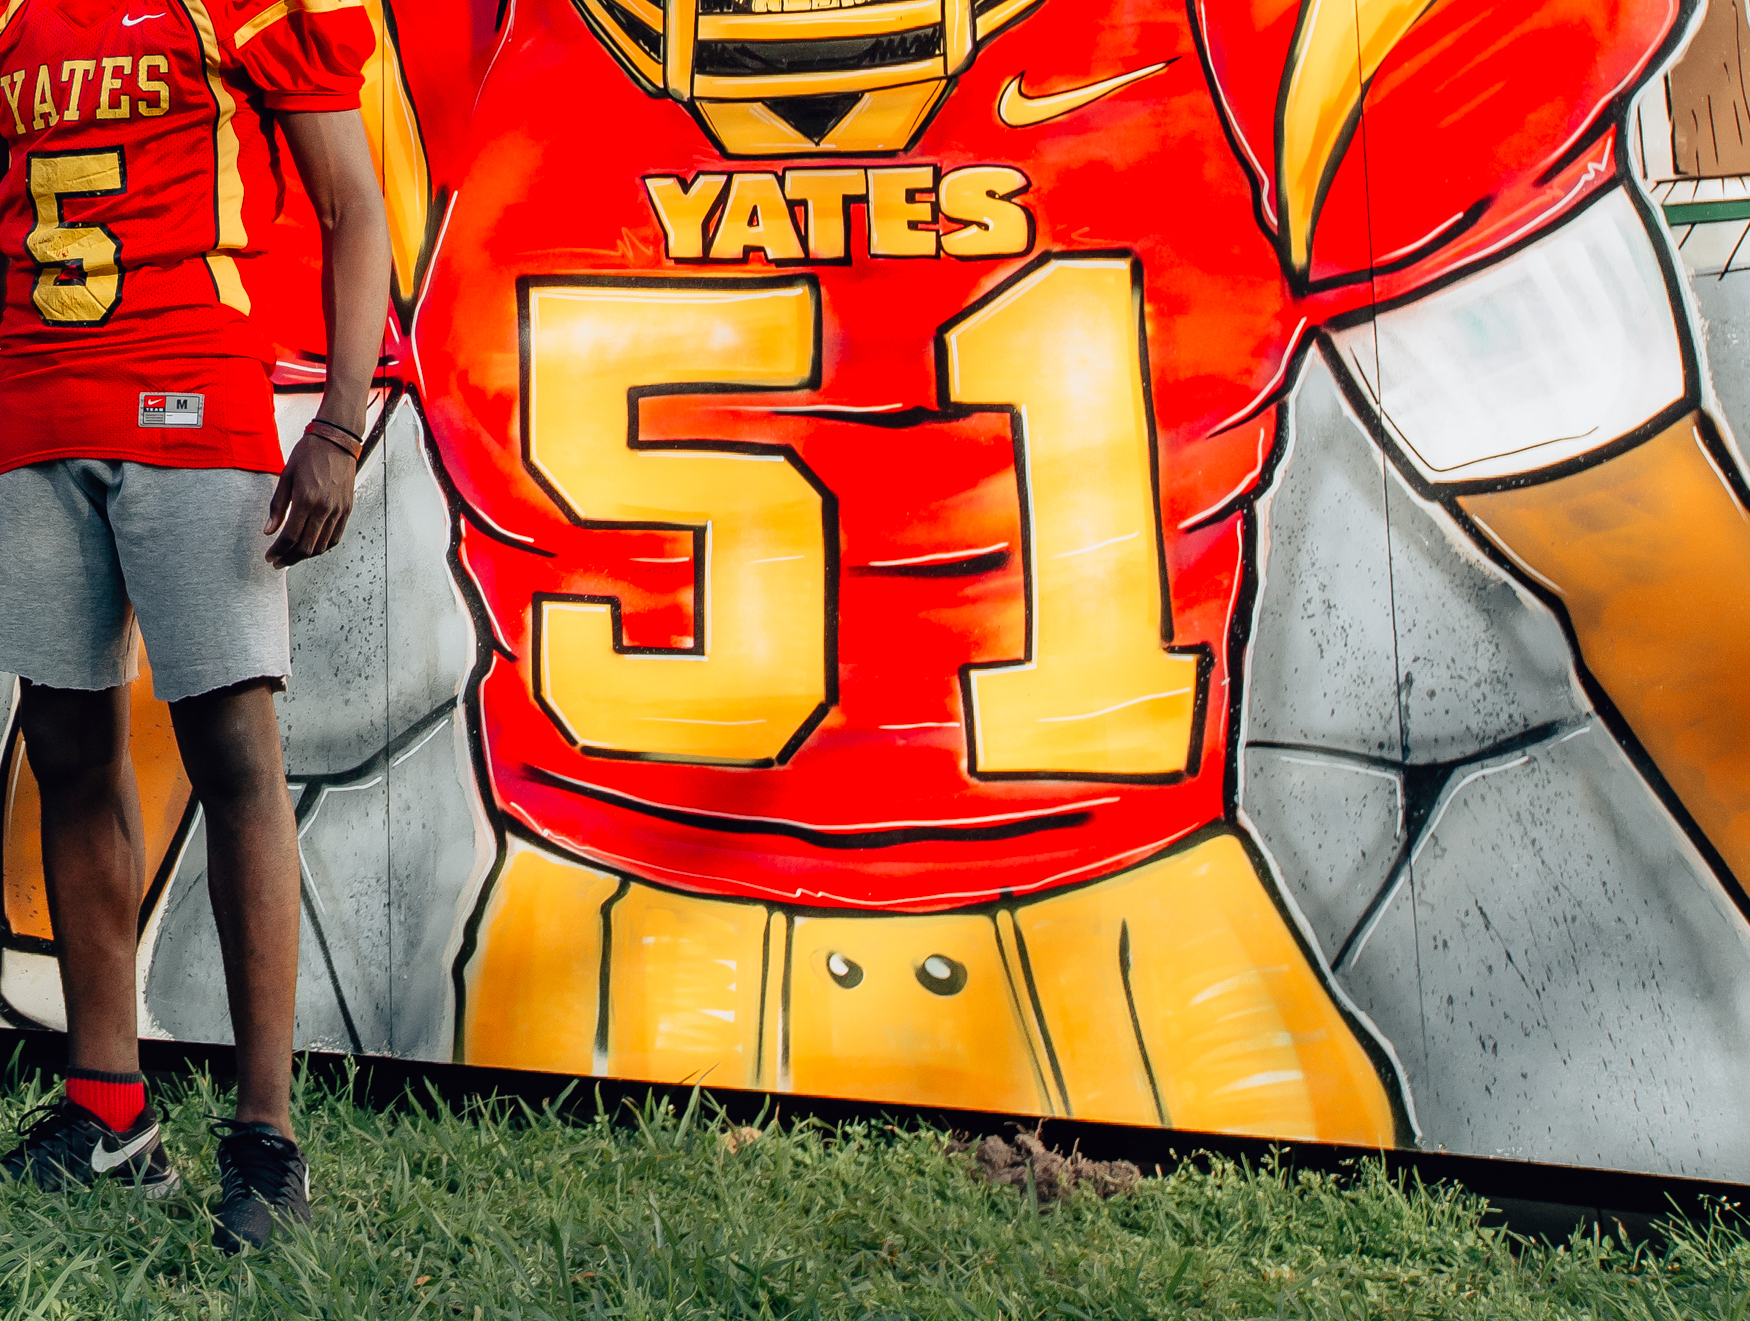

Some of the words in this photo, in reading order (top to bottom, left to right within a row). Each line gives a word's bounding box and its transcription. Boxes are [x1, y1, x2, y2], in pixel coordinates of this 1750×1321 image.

[0, 53, 172, 136] YATES
[23, 145, 129, 328] 5
[641, 164, 1038, 267] YATES
[176, 399, 188, 410] M
[517, 248, 1216, 783] 51
